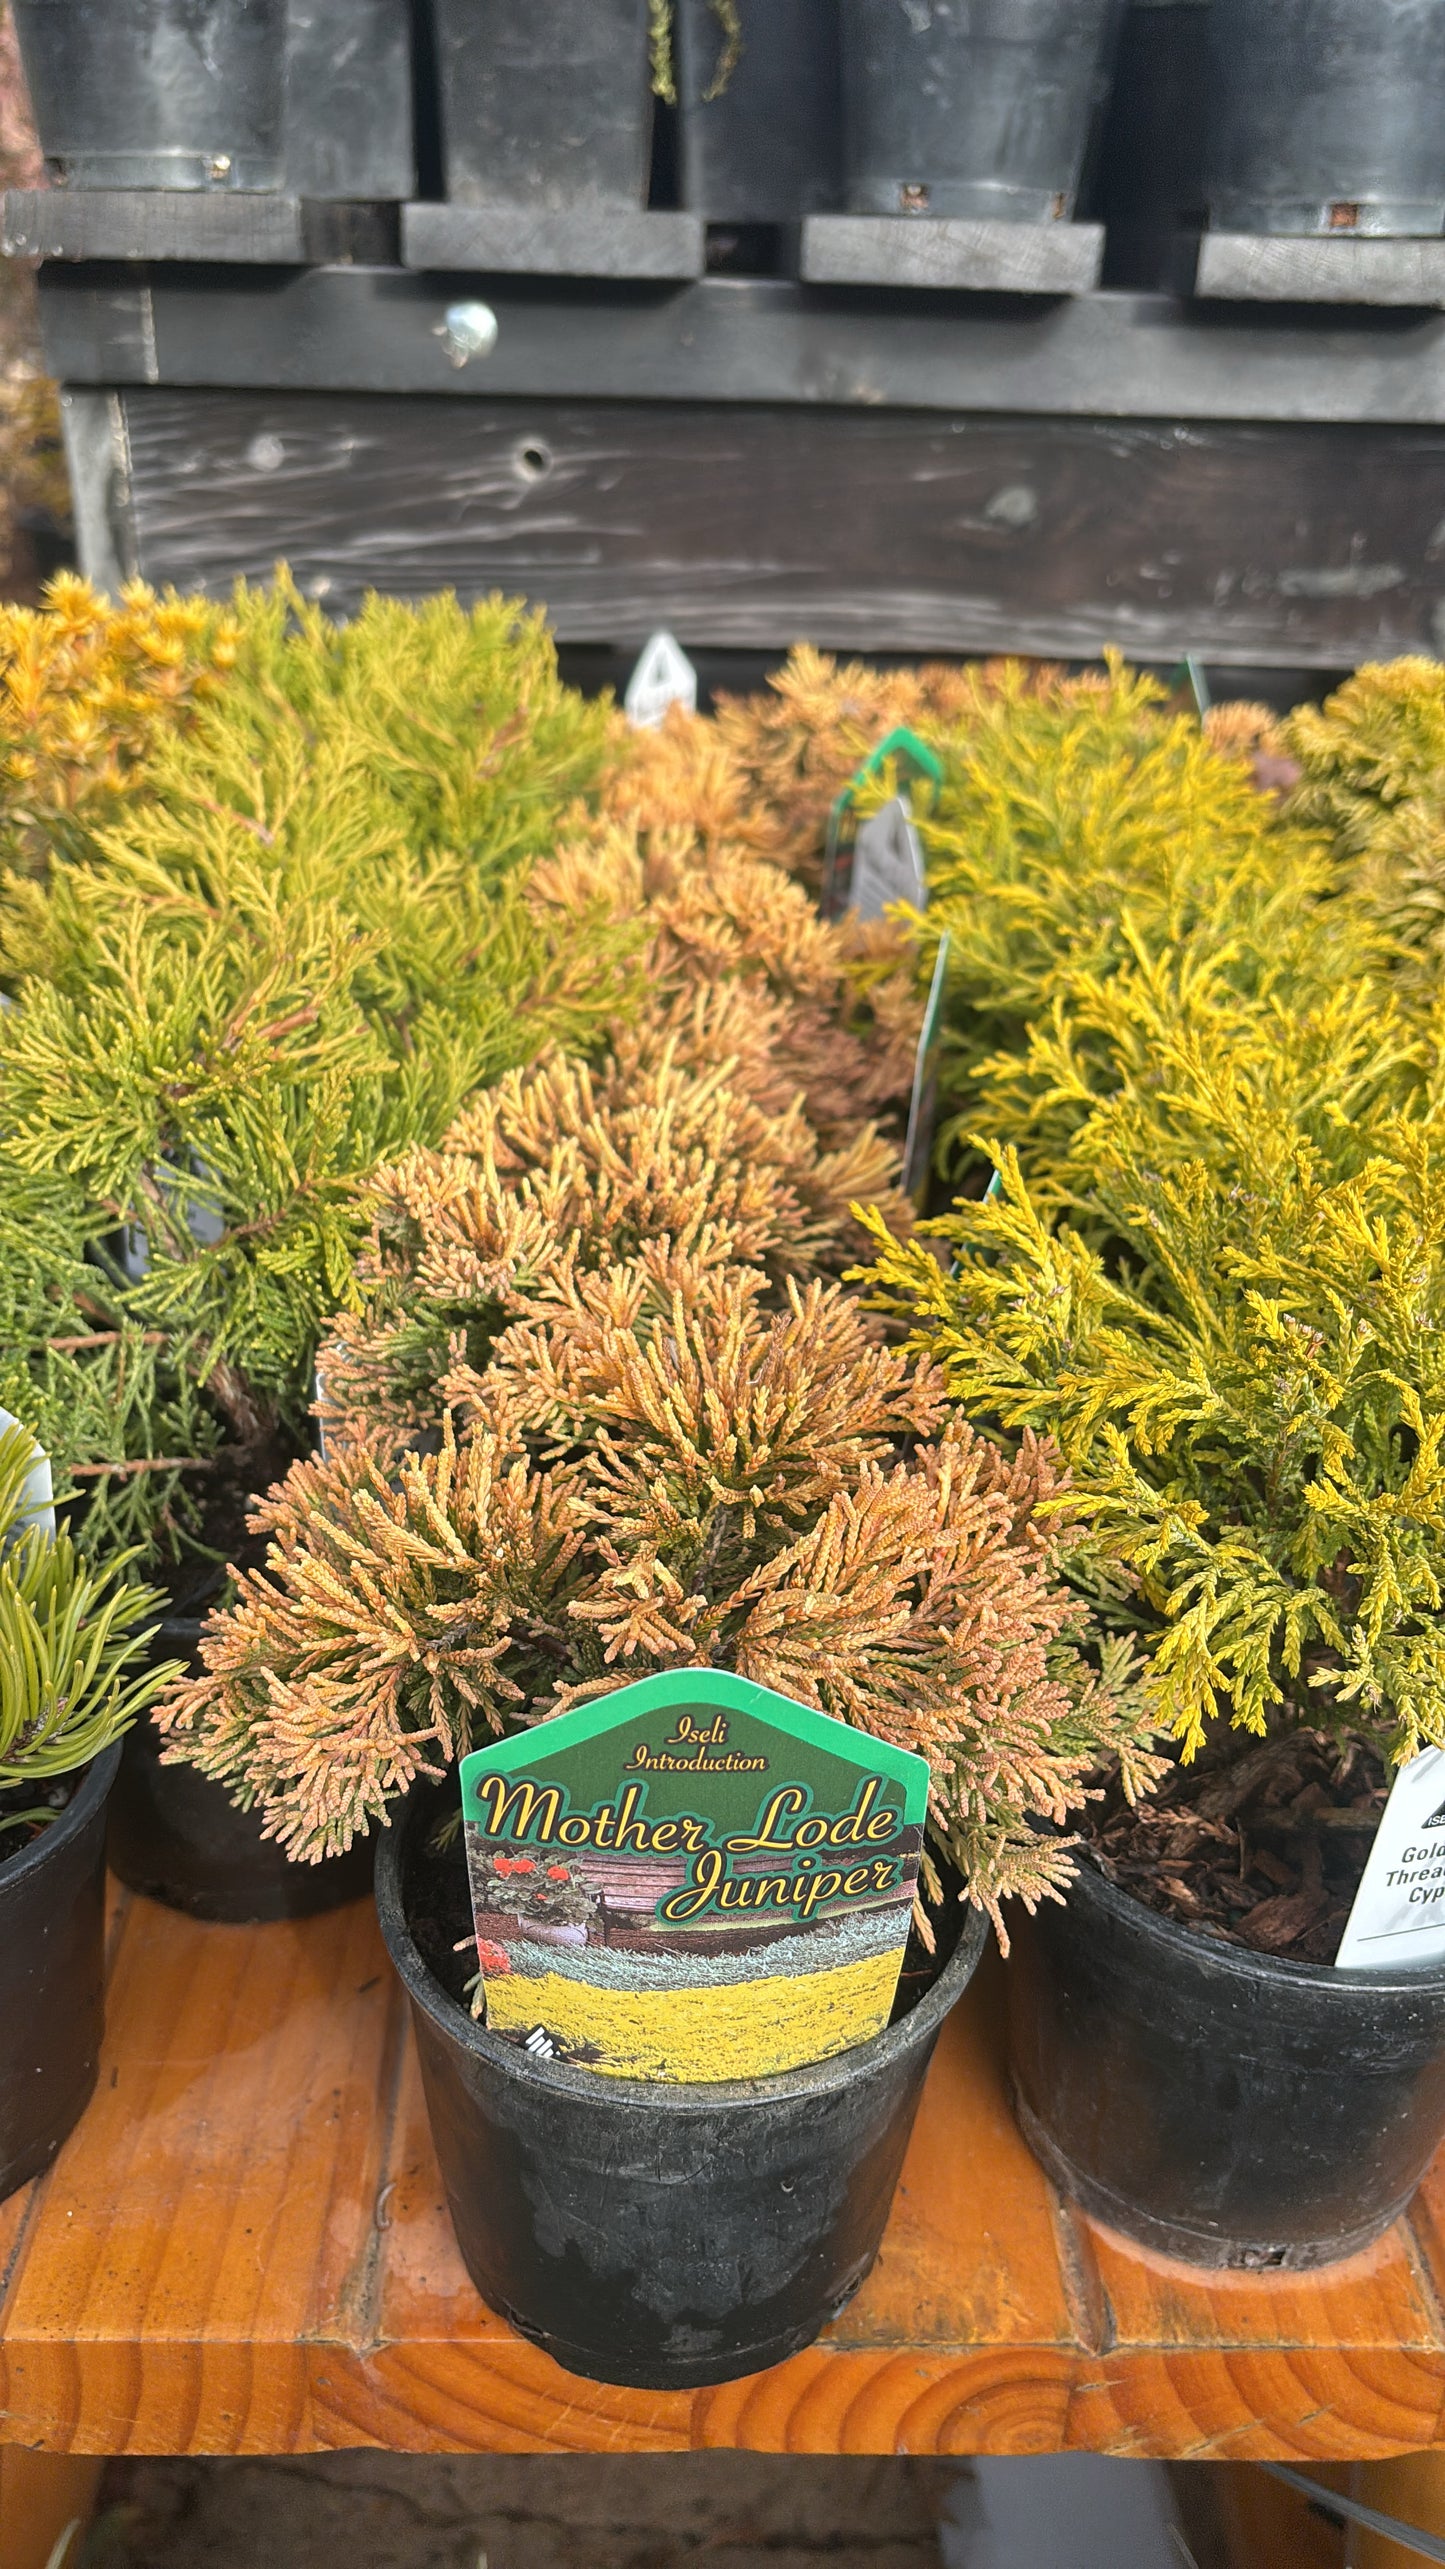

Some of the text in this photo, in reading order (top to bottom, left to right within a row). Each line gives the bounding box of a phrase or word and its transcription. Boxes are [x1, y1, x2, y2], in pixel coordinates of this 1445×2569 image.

[666, 1713, 728, 1745] Iseli
[624, 1744, 767, 1772] Introduction
[480, 1775, 894, 1852] Mother Lode
[664, 1849, 896, 1920] Juniper
